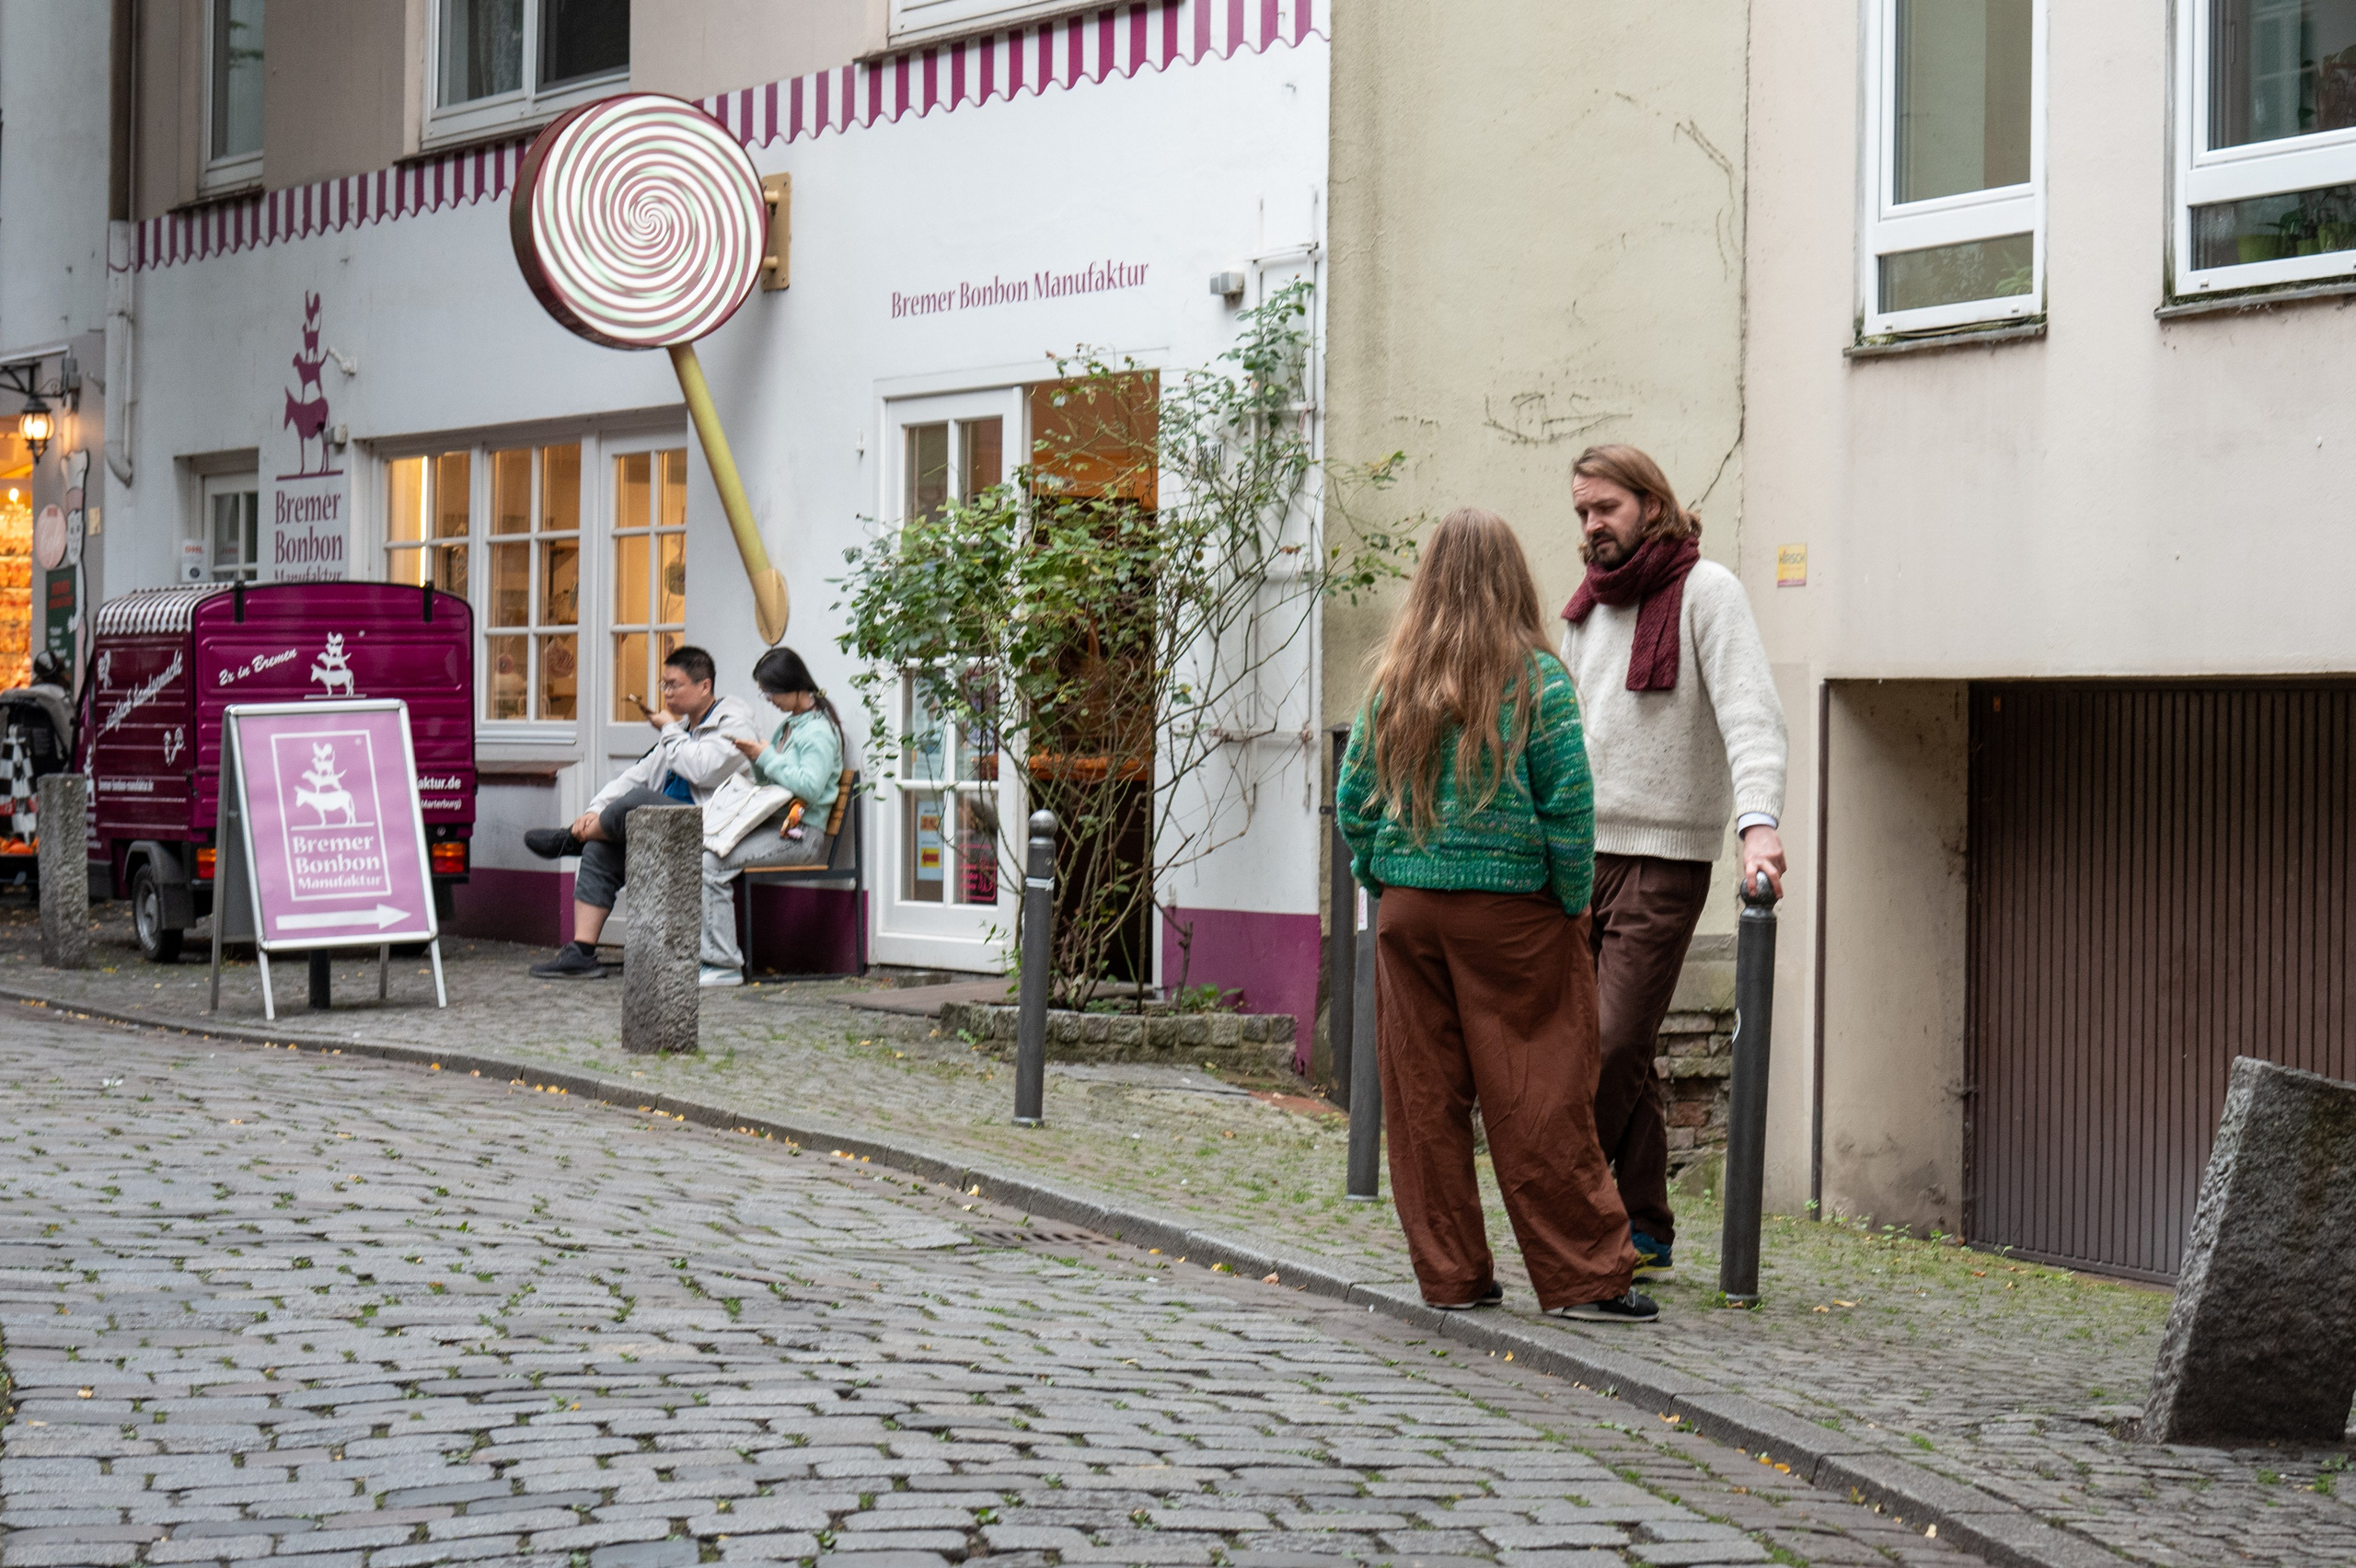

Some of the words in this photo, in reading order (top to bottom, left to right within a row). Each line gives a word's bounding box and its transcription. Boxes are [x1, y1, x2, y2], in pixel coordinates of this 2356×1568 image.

[891, 289, 956, 318] Bremer
[959, 275, 1029, 310] Bonbon
[1034, 259, 1149, 301] Manufaktur
[275, 490, 341, 525] Bremer
[275, 525, 342, 564] Bonbon
[219, 668, 235, 686] 2x
[237, 665, 250, 679] in
[251, 648, 297, 674] Bremen
[293, 836, 375, 854] Bremer
[295, 853, 380, 874] Bonbon
[298, 873, 382, 890] Manufaktur
